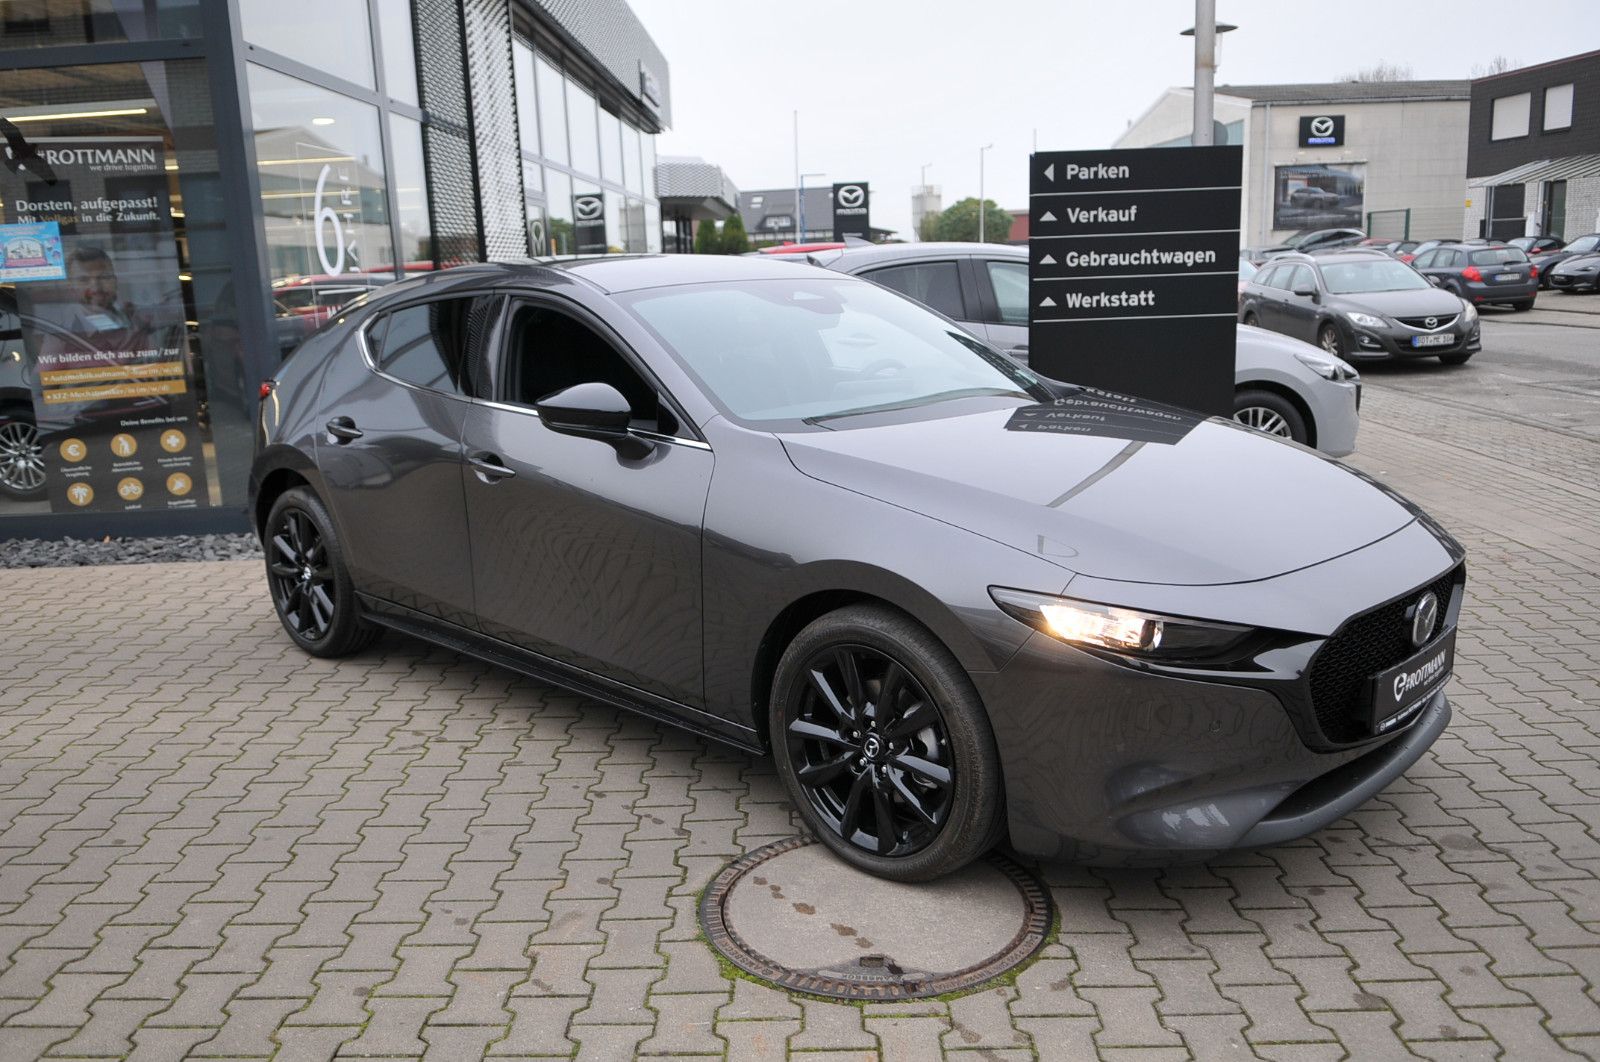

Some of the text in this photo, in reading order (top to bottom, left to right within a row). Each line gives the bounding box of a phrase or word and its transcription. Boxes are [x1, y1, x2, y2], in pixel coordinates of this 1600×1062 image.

[104, 163, 123, 171] drive
[125, 162, 157, 172] together
[1066, 163, 1130, 180] Parken
[16, 196, 158, 212] Dorsten, aufgepasst!
[82, 213, 93, 223] in
[96, 212, 113, 222] die
[117, 210, 160, 222] Zukunft.
[314, 163, 345, 277] 6
[1067, 205, 1137, 223] Verkauf
[1066, 249, 1216, 267] Gebrauchtwagen
[1066, 290, 1155, 308] Werkstatt
[38, 355, 57, 363] Wir
[59, 353, 91, 362] bilden
[94, 350, 115, 360] dich
[140, 417, 165, 425] Benefits
